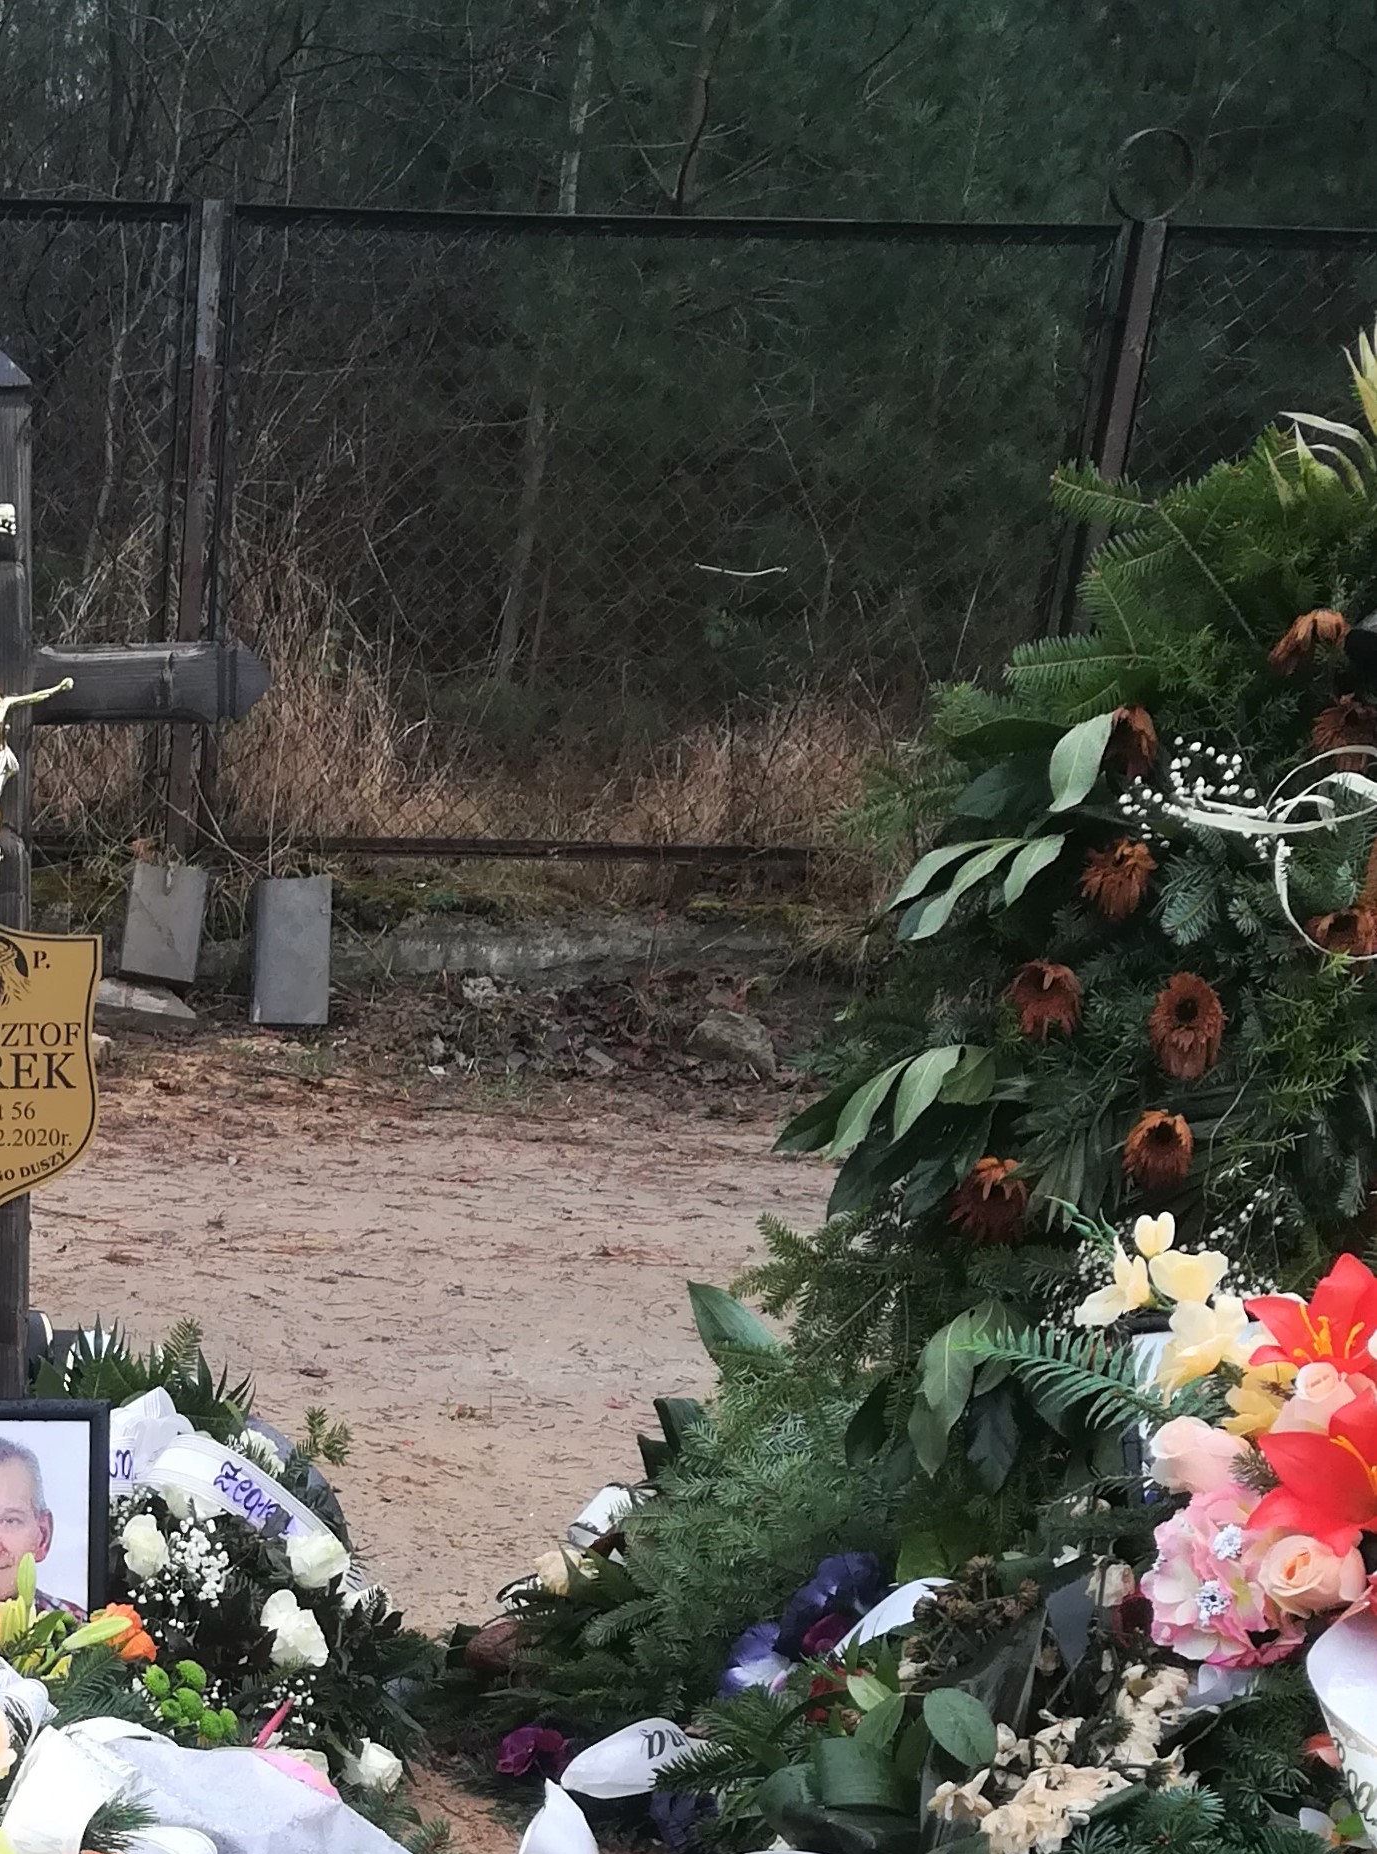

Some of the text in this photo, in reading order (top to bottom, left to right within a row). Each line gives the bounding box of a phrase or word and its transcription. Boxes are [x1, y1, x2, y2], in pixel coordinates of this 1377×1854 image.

[33, 950, 51, 969] P.
[11, 1101, 36, 1120] 56
[20, 1148, 67, 1178] DUSZY
